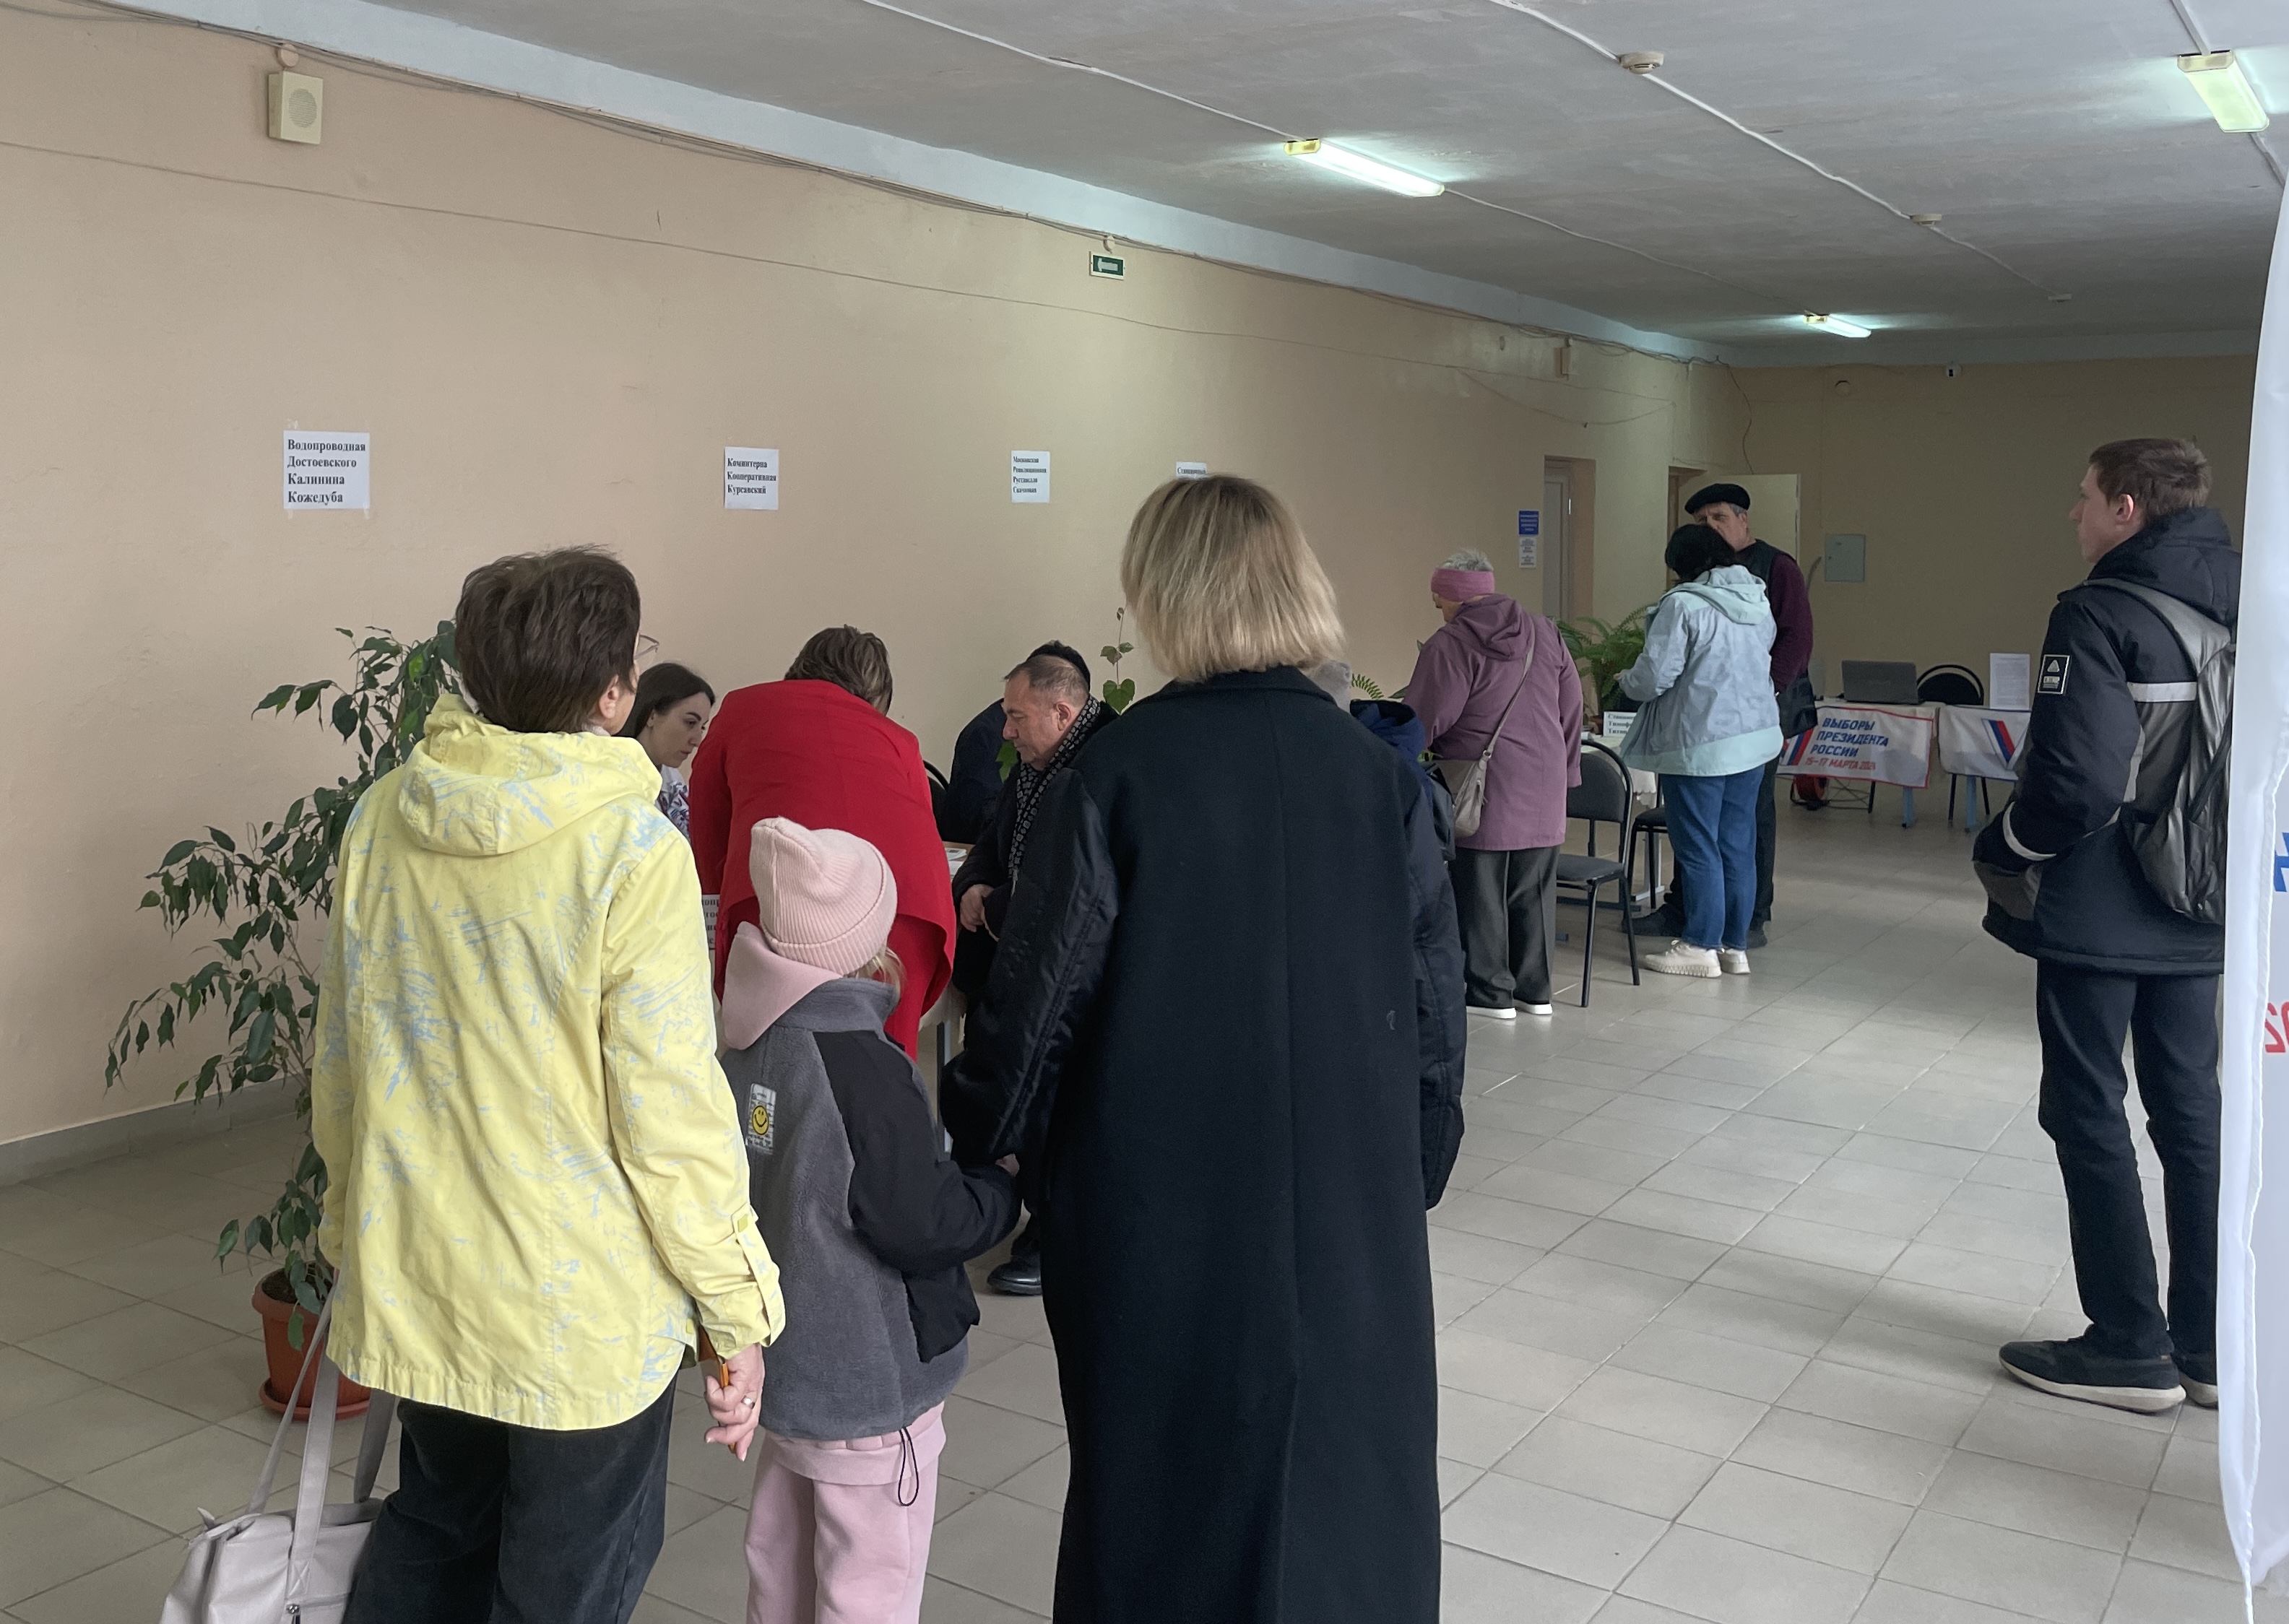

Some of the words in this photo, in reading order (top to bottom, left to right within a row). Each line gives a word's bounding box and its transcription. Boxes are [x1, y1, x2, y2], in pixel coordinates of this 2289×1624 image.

[287, 438, 366, 453] Водопроводная
[287, 456, 358, 469] Достоевского
[287, 472, 345, 485] Калинина
[727, 471, 776, 483] Кооперативная
[727, 485, 766, 496] Курсавский
[287, 490, 344, 506] Кожедуба
[1822, 717, 1876, 731] ВЫБОРЫ
[1816, 731, 1890, 747] ПРЕЗИДЕНТА
[1810, 744, 1859, 757] РОССИИ
[1829, 759, 1859, 770] МАРТА
